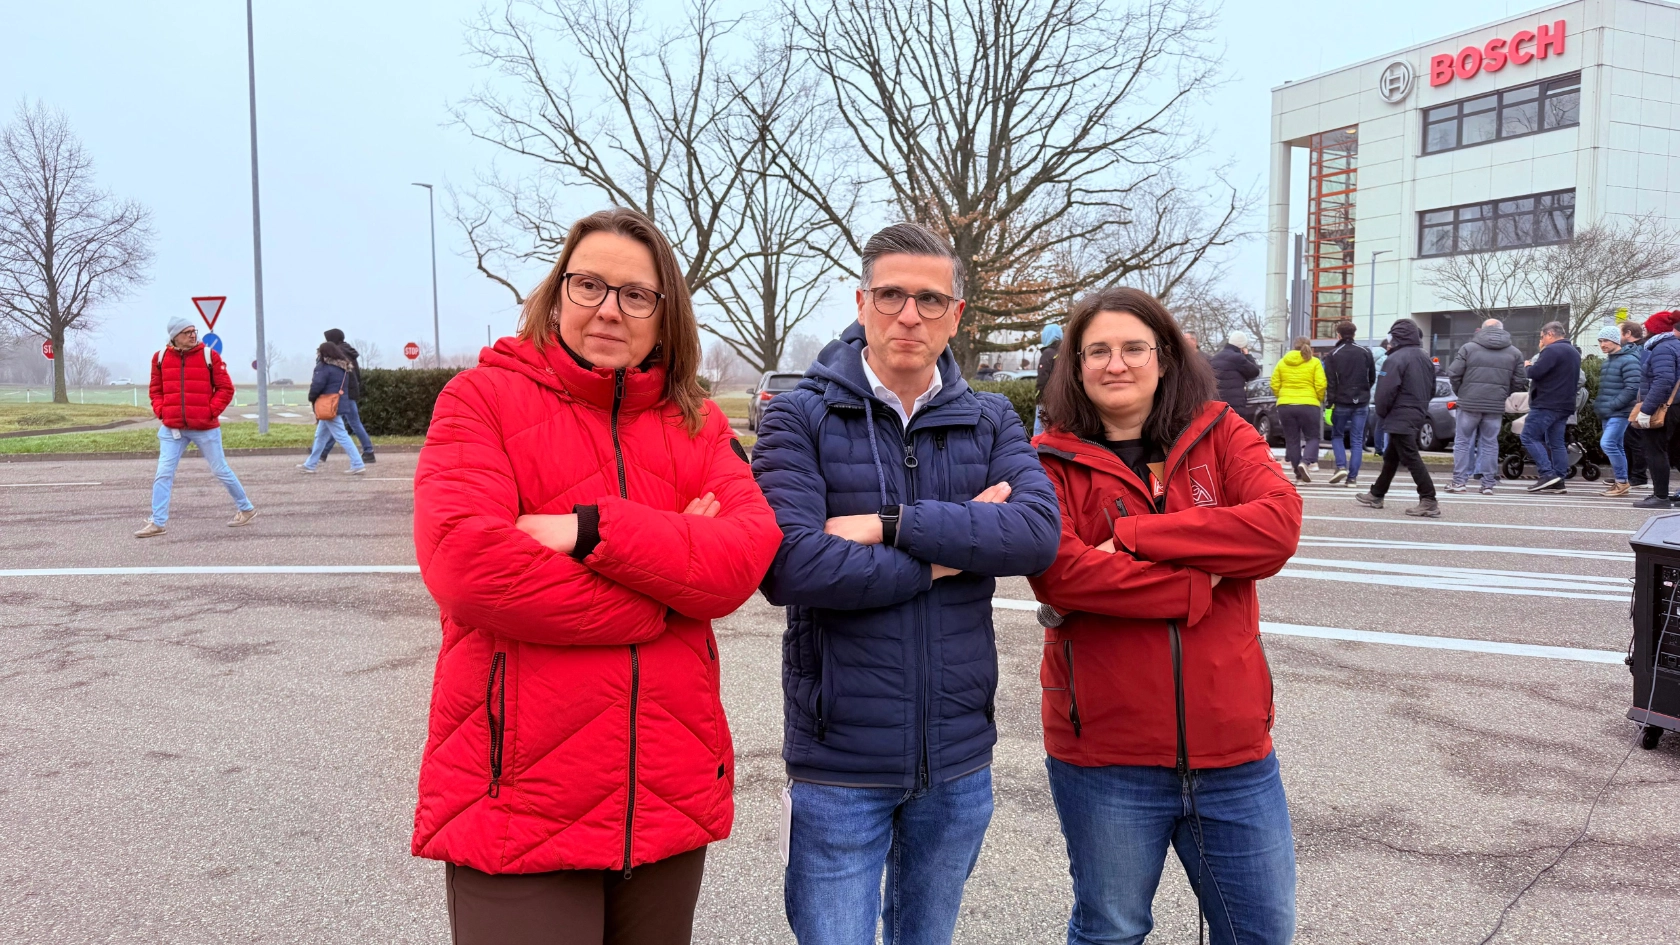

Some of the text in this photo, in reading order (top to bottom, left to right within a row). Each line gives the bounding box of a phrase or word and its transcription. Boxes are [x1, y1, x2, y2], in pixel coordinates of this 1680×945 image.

[1430, 19, 1566, 87] BOSCH
[43, 344, 53, 354] ST
[405, 347, 419, 355] STOP
